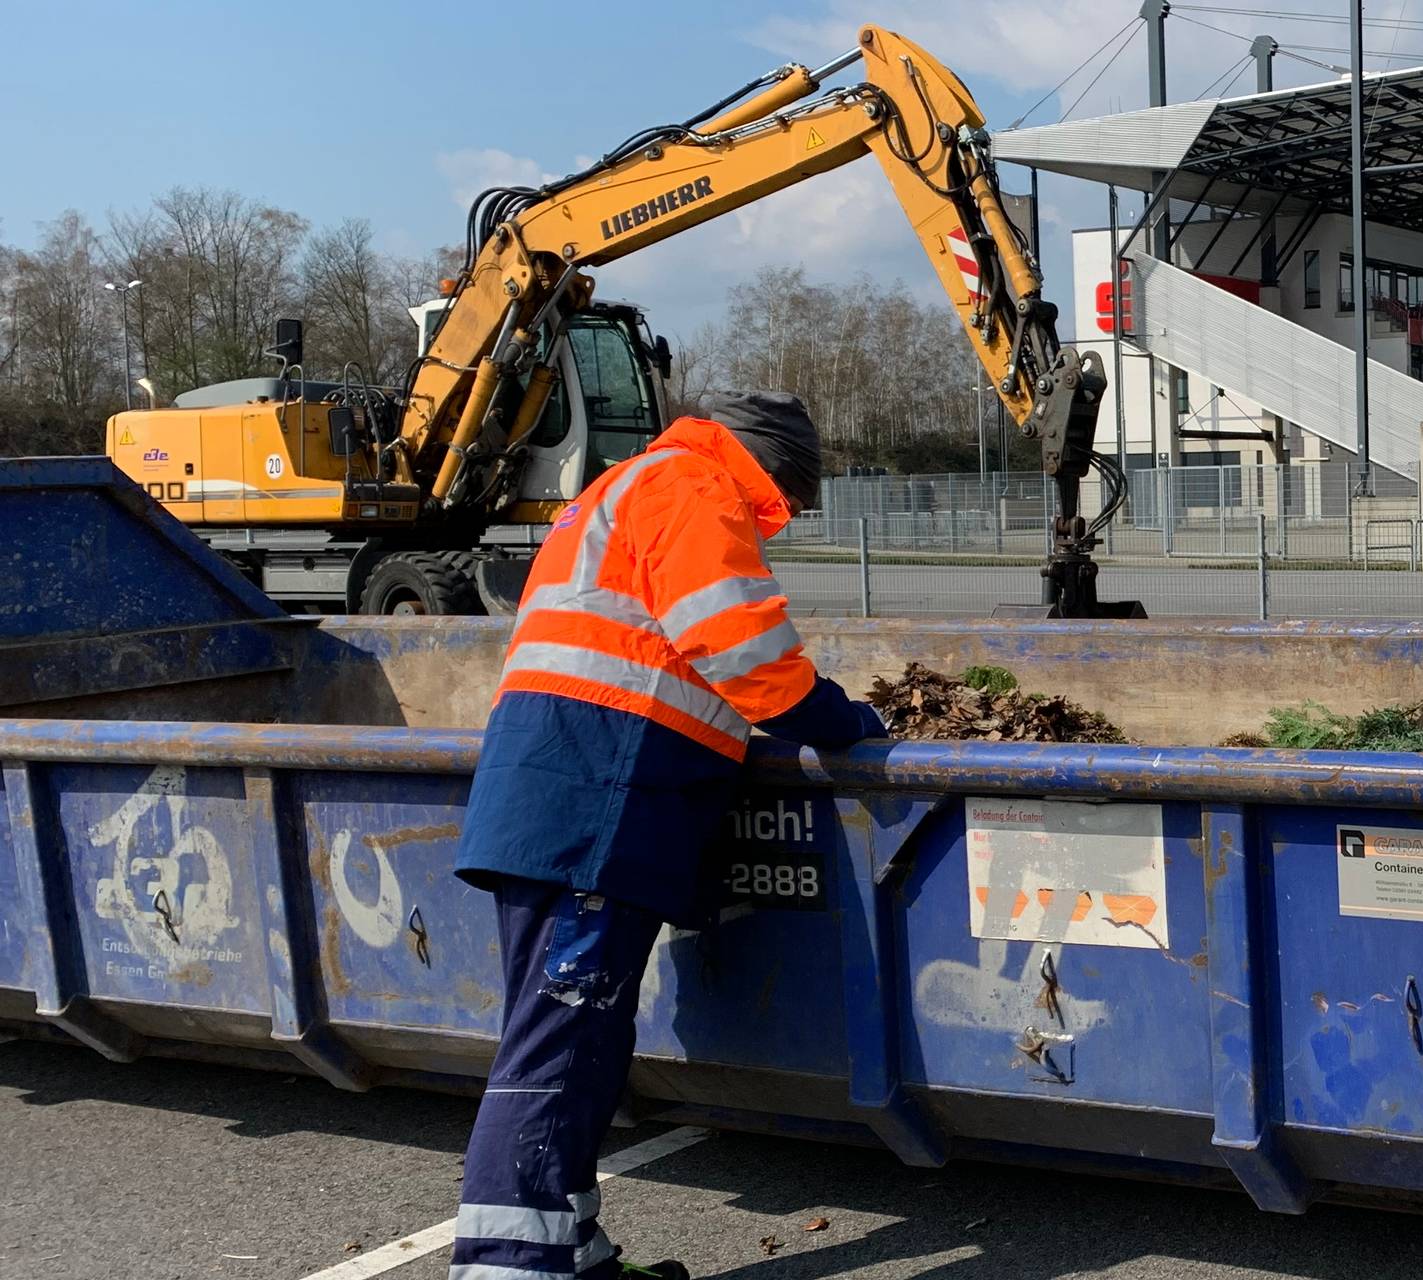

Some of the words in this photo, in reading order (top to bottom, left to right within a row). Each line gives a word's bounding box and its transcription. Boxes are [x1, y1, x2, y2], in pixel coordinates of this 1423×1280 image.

[600, 175, 715, 241] LIEBHERR
[269, 458, 281, 474] 20
[137, 482, 184, 500] 00
